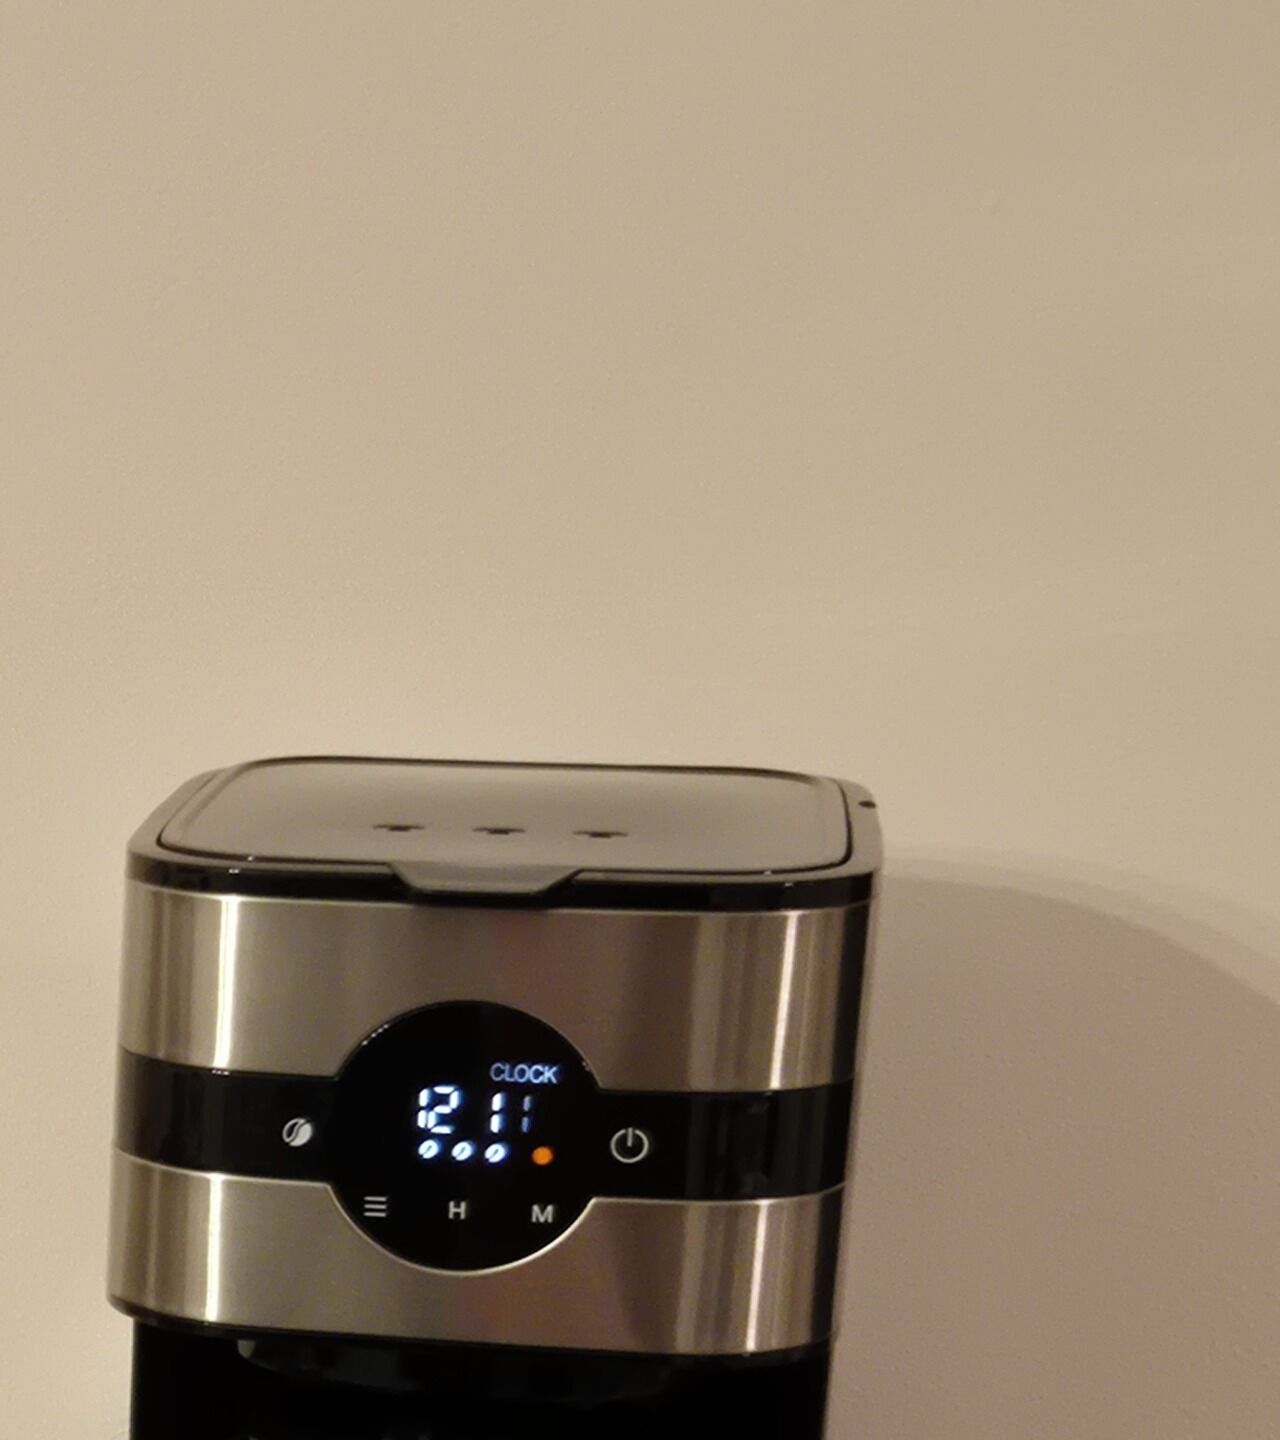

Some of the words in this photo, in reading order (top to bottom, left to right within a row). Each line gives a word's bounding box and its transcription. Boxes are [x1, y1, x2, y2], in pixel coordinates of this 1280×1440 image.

[490, 1062, 557, 1084] CLOCK
[448, 1201, 467, 1220] H
[532, 1204, 554, 1224] M
